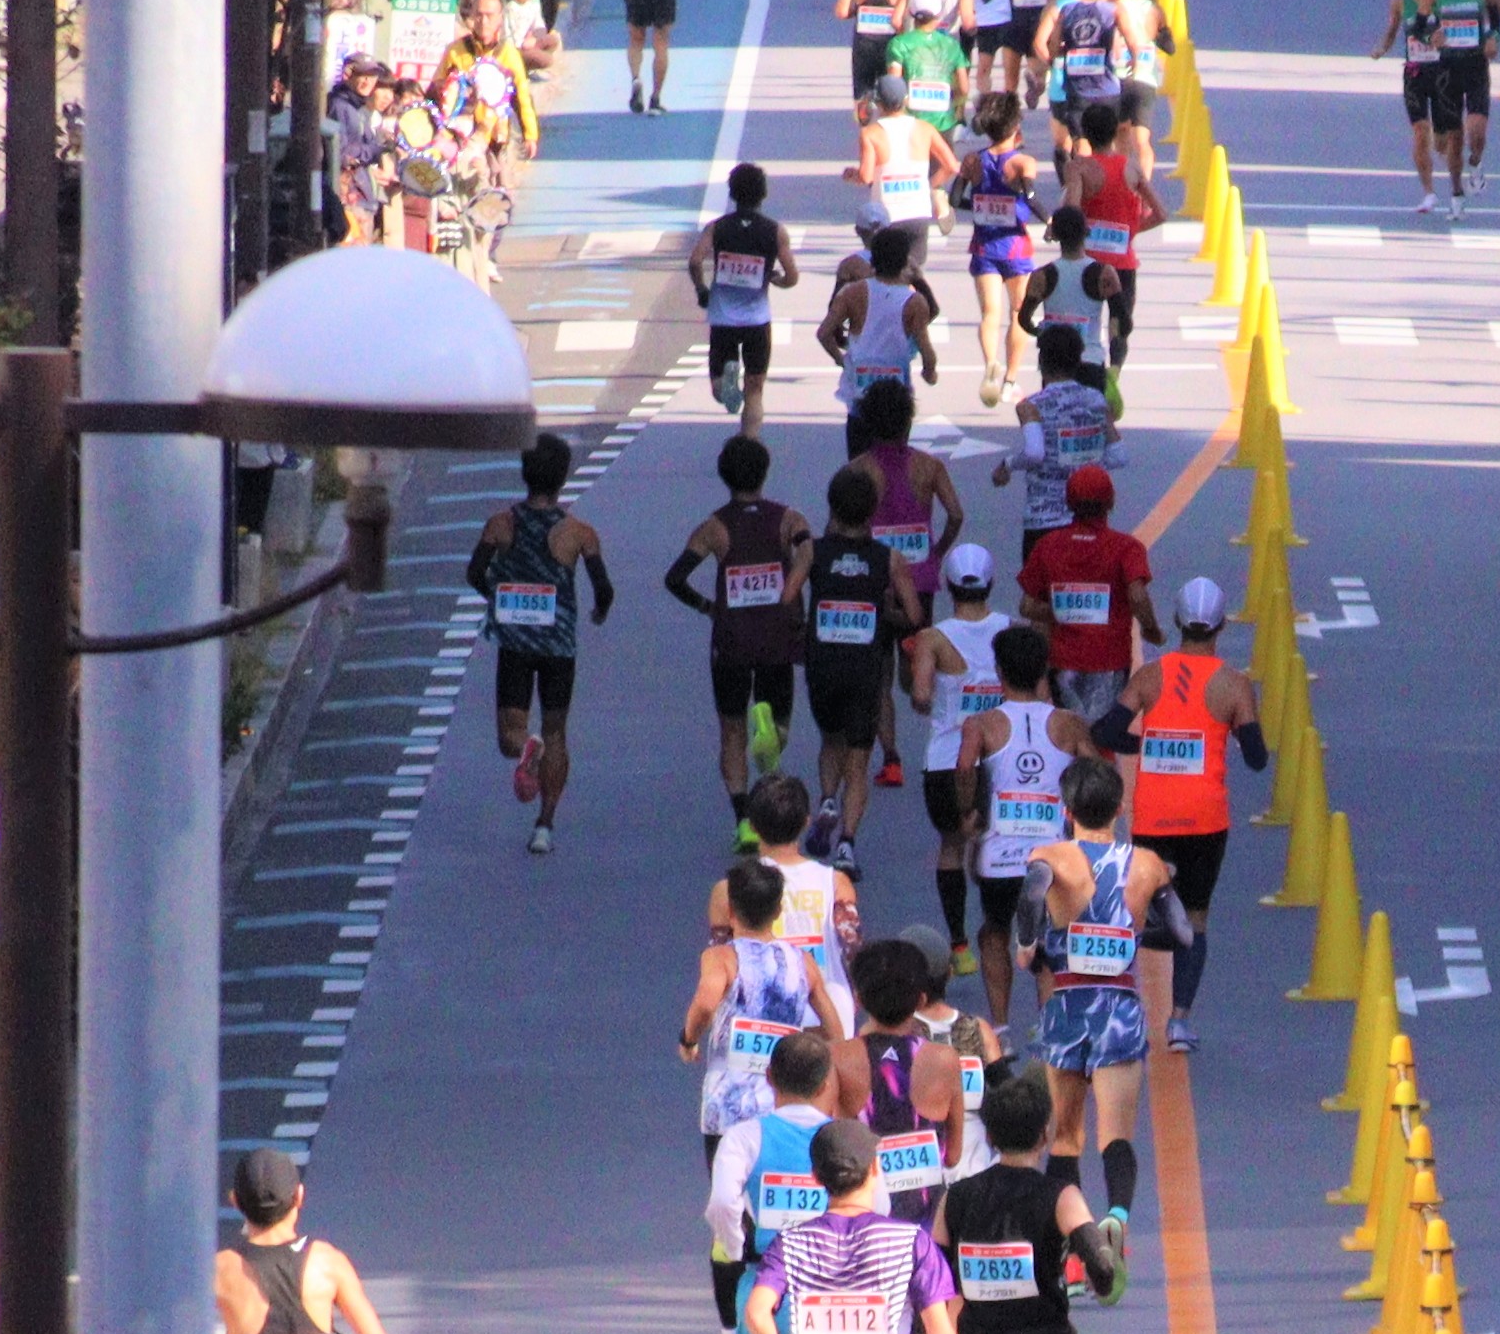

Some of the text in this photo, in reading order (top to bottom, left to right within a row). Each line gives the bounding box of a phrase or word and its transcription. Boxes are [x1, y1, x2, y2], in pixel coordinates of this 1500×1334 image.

[514, 594, 548, 610] 1553
[833, 613, 870, 629] 4040
[1145, 740, 1196, 759] B 1401
[999, 803, 1054, 821] B 5190
[1071, 937, 1127, 958] B 2554
[733, 1030, 744, 1050] B
[880, 1147, 930, 1174] 3334
[765, 1190, 775, 1207] B
[963, 1258, 1024, 1281] B 2632
[804, 1308, 877, 1331] A 1112
